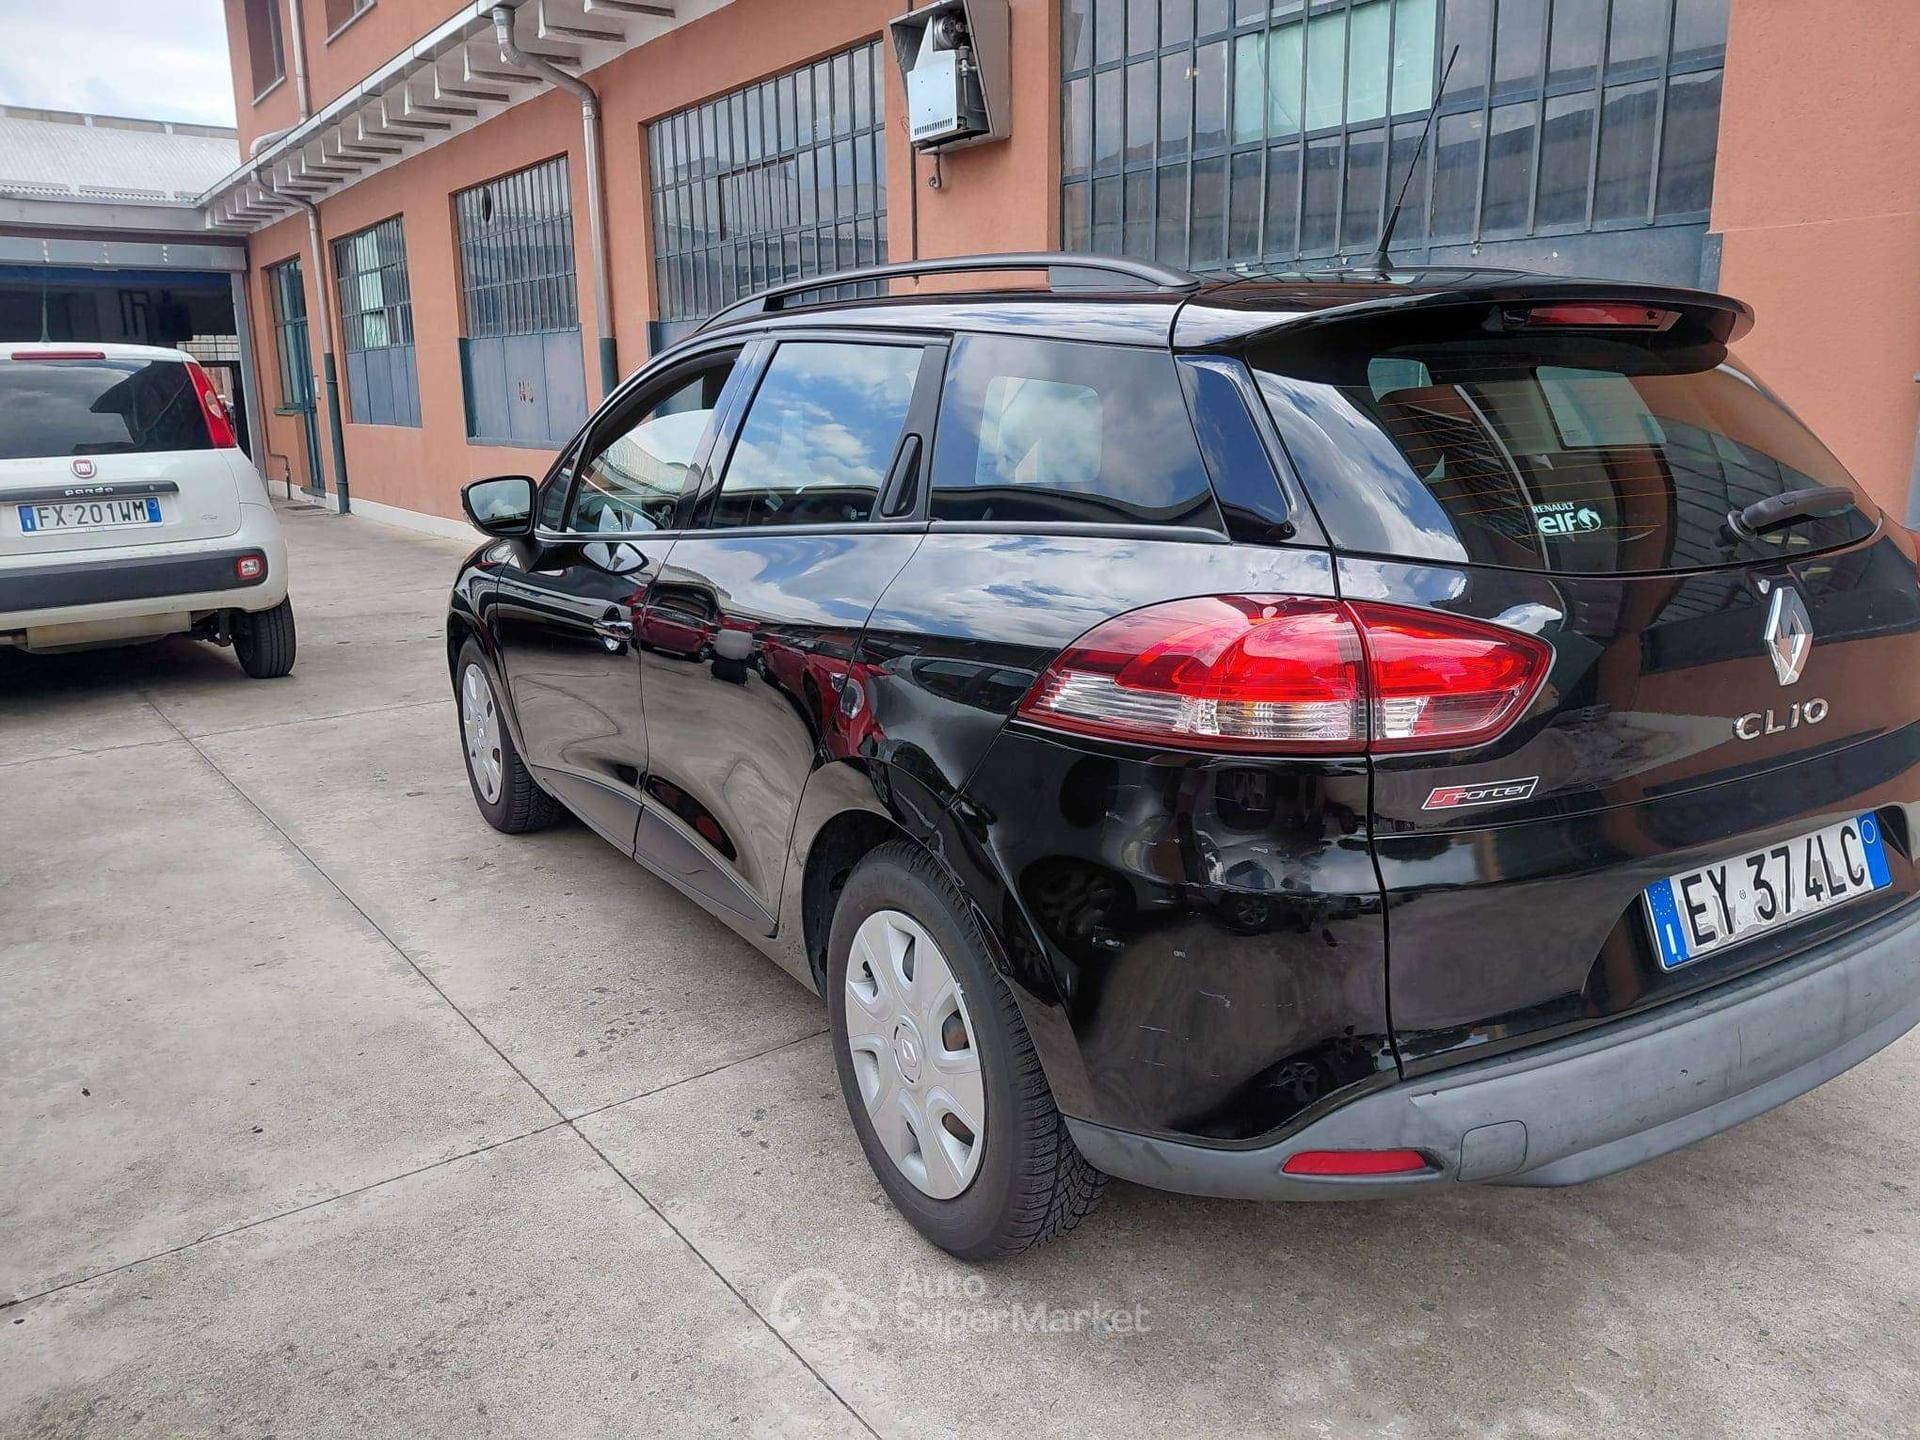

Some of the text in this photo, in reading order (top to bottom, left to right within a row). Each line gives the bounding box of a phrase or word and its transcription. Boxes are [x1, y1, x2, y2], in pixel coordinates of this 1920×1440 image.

[36, 505, 67, 528] FX
[74, 501, 147, 525] 201WM
[1531, 502, 1575, 514] RENAULT
[1538, 512, 1577, 533] elf
[1732, 697, 1829, 740] CLIO
[1680, 865, 1734, 947] EY
[1746, 825, 1866, 921] 374LC
